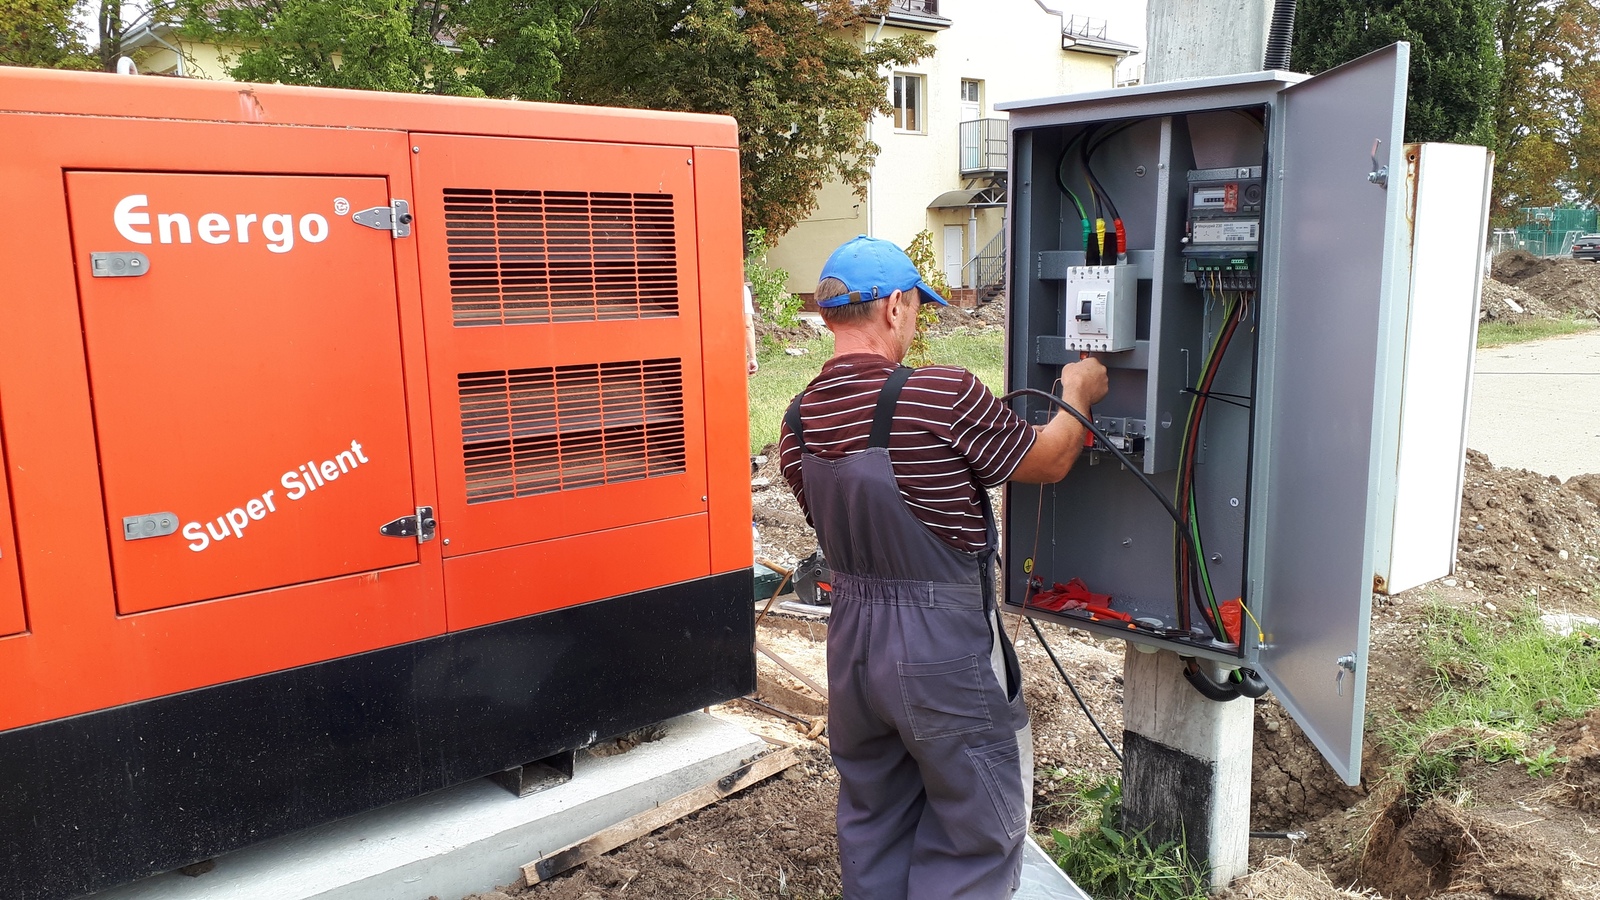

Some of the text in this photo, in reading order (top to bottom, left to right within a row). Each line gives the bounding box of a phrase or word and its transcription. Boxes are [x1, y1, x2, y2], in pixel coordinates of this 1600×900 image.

[113, 194, 329, 253] Energo
[182, 439, 369, 552] Super Silent
